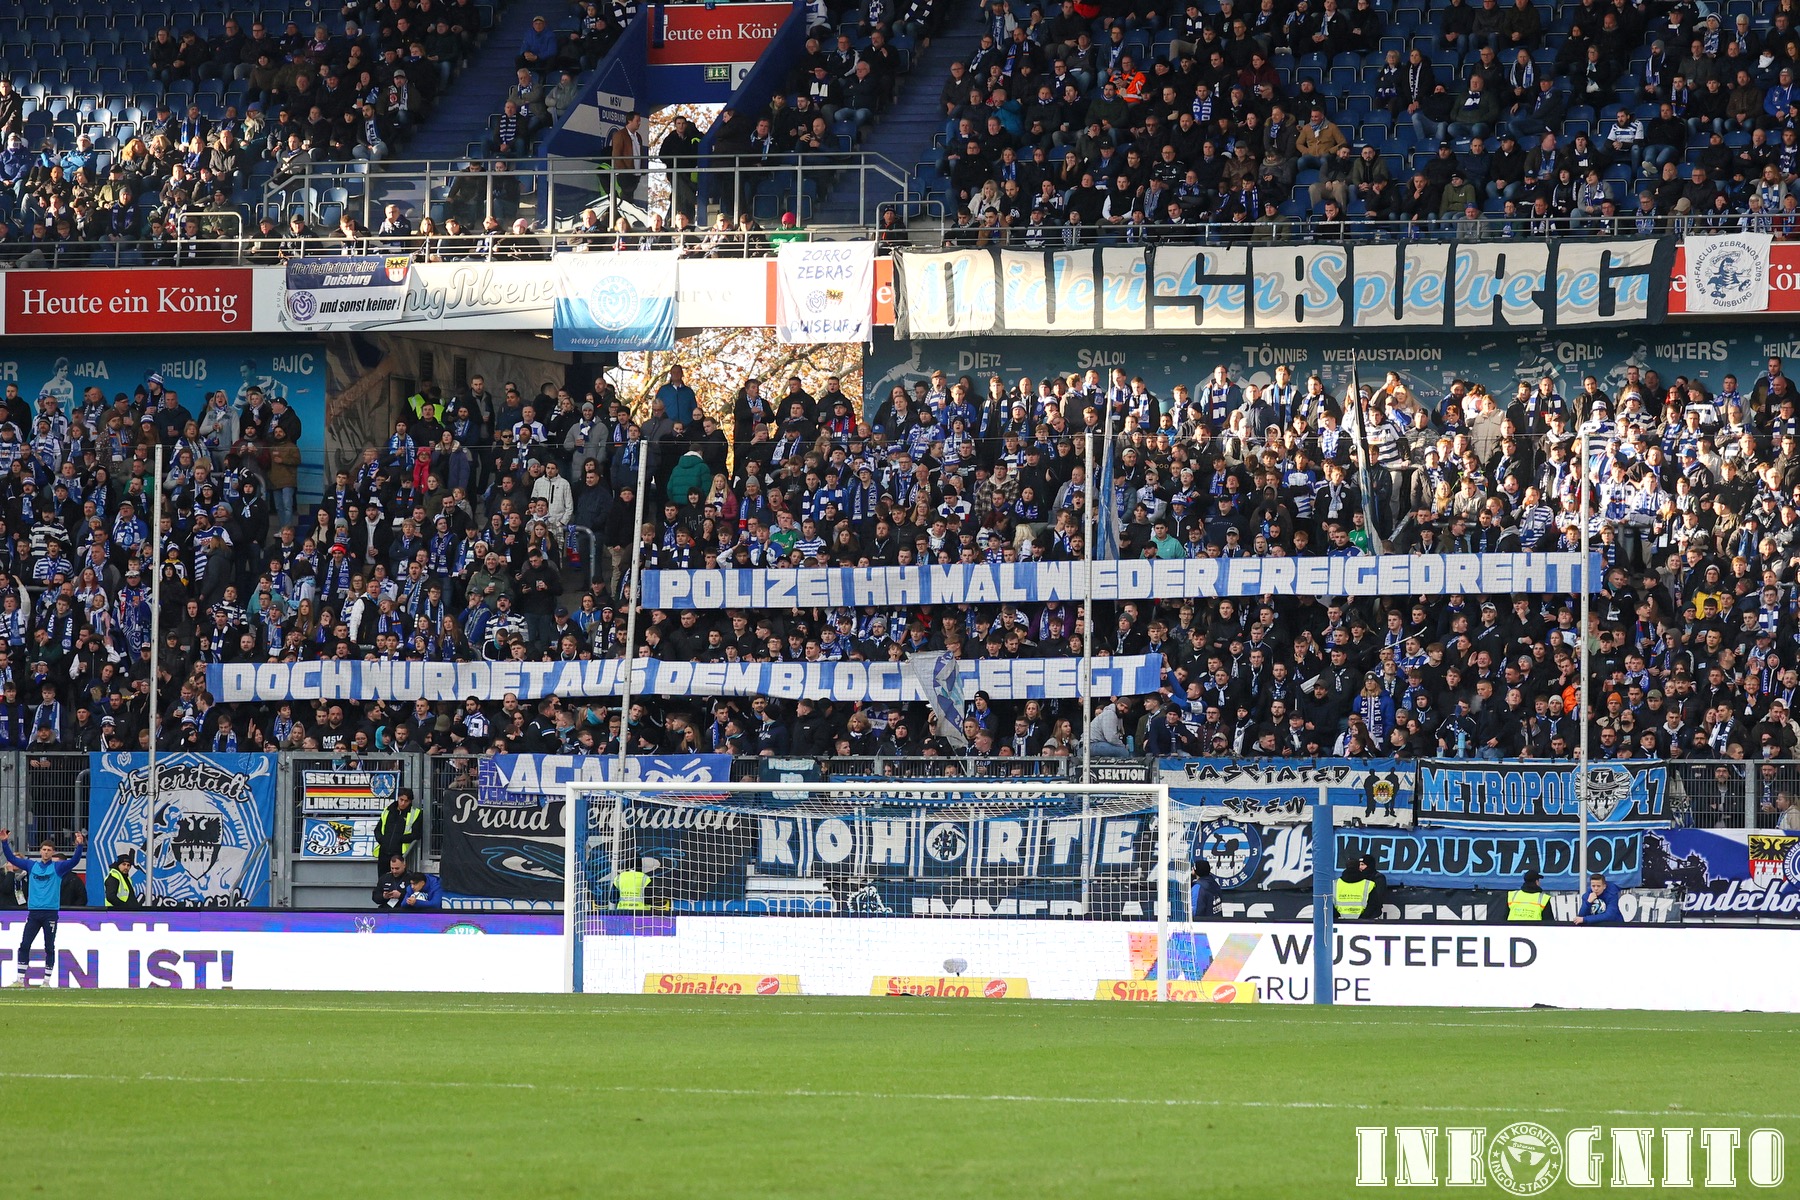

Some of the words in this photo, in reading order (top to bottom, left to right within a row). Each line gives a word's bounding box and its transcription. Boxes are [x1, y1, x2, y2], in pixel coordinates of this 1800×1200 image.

[707, 24, 732, 40] ein
[738, 22, 778, 40] Köni
[609, 96, 622, 108] MSV
[802, 248, 852, 263] ZORRO
[1719, 241, 1759, 261] ZEBRANOS
[290, 262, 308, 276] Hier
[355, 261, 379, 273] einer
[797, 265, 854, 280] ZEBRAS
[322, 274, 372, 287] Duisburg
[446, 265, 556, 310] Pilsene
[22, 288, 102, 315] Heute
[109, 288, 150, 314] ein
[157, 287, 238, 323] König
[319, 300, 336, 314] und
[338, 299, 366, 313] sonst
[1713, 291, 1753, 308] DUISBURG
[959, 350, 1001, 371] DIETZ
[1077, 349, 1126, 369] SALOU
[1243, 343, 1308, 368] TÖNNIES
[1322, 348, 1442, 362] WEDAUSTADION
[1557, 341, 1603, 364] GRLIC
[1655, 340, 1728, 361] WOLTERS
[74, 360, 109, 380] JARA
[272, 353, 314, 375] BAJIC
[659, 567, 833, 609] POLIZEI
[853, 566, 920, 607] HH
[930, 563, 1027, 604] MAL
[1037, 559, 1219, 601] WIEDER
[1228, 553, 1583, 598] FREIGEDREHT
[222, 661, 352, 702] DOCH
[361, 660, 554, 701] WURDET
[553, 658, 648, 699] AUS
[656, 660, 763, 697] DEM
[306, 773, 371, 785] SEKTION
[1098, 768, 1145, 781] SEKTION
[1594, 771, 1610, 783] 47
[1631, 765, 1668, 816] 47
[452, 792, 551, 831] Proud
[1335, 833, 1641, 875] WEDAUSTADION
[129, 949, 234, 989] IST!
[658, 974, 742, 994] Sinalco
[887, 977, 970, 998] Sinalco
